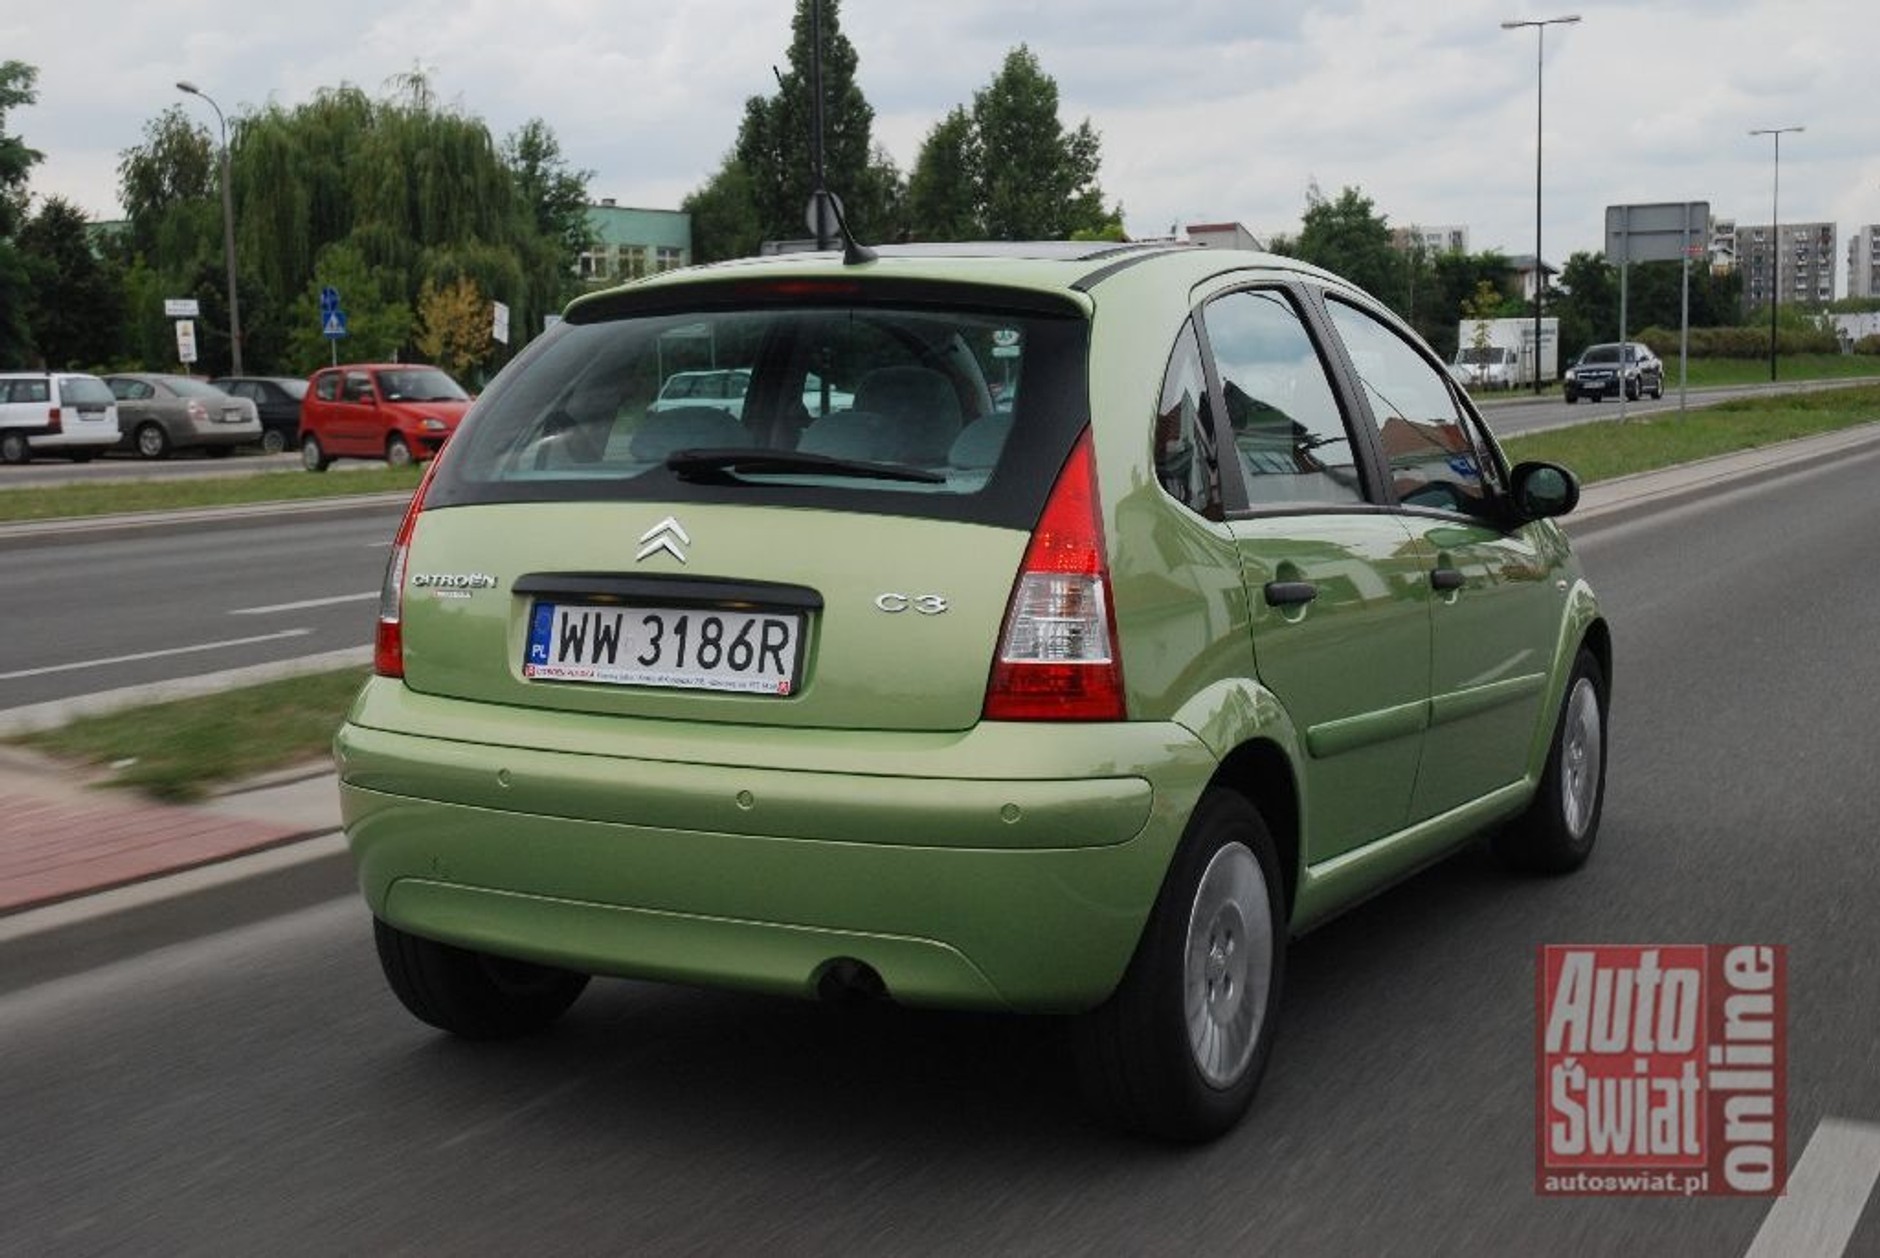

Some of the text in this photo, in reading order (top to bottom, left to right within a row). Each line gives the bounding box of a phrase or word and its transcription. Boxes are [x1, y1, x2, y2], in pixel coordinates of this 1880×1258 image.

[412, 573, 498, 588] CITROËN
[875, 593, 948, 615] C3
[531, 644, 547, 659] PL
[557, 610, 789, 675] WW 3186R
